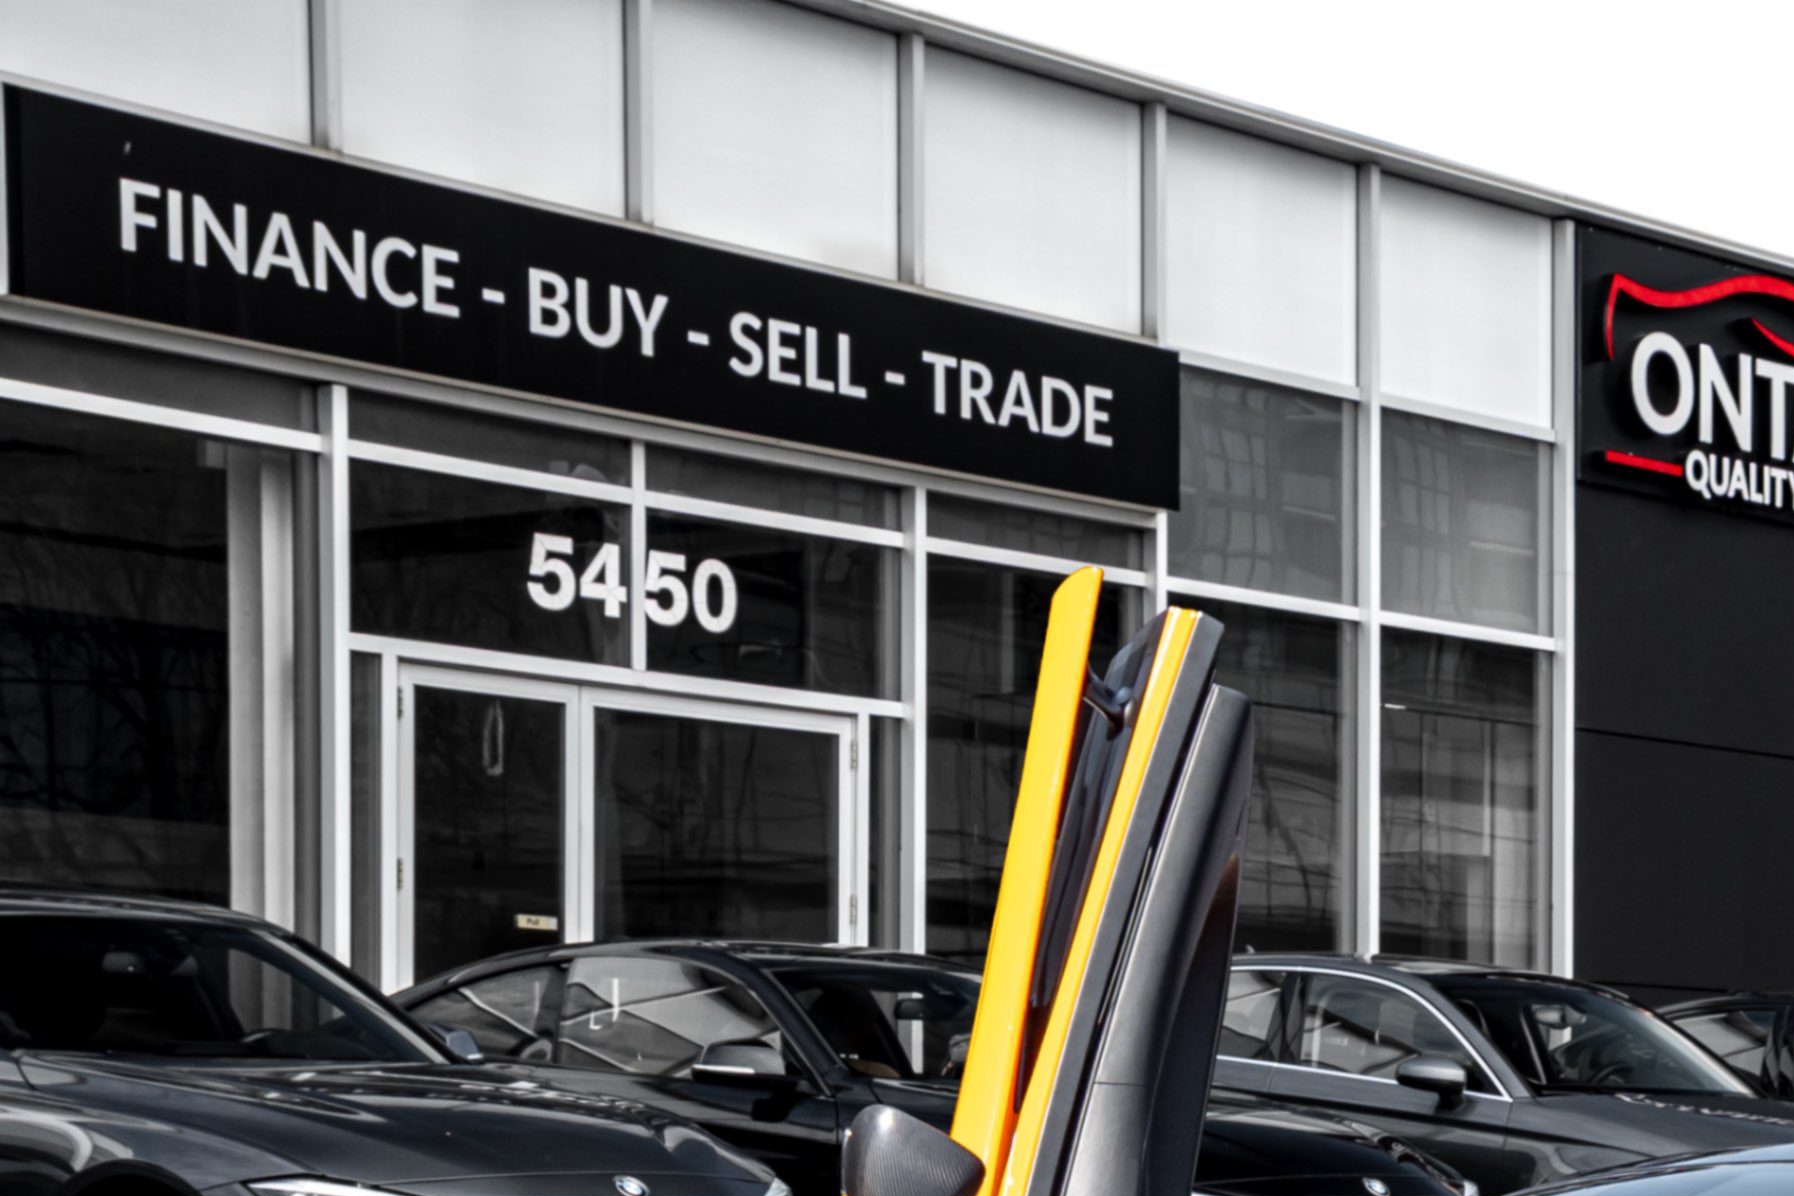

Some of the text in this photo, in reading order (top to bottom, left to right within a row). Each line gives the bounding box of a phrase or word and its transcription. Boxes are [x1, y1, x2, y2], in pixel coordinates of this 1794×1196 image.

[118, 177, 461, 319] FINANCE
[527, 267, 670, 358] BUY
[728, 311, 868, 400] SELL
[920, 350, 1114, 448] TRADE
[526, 531, 738, 634] 5450
